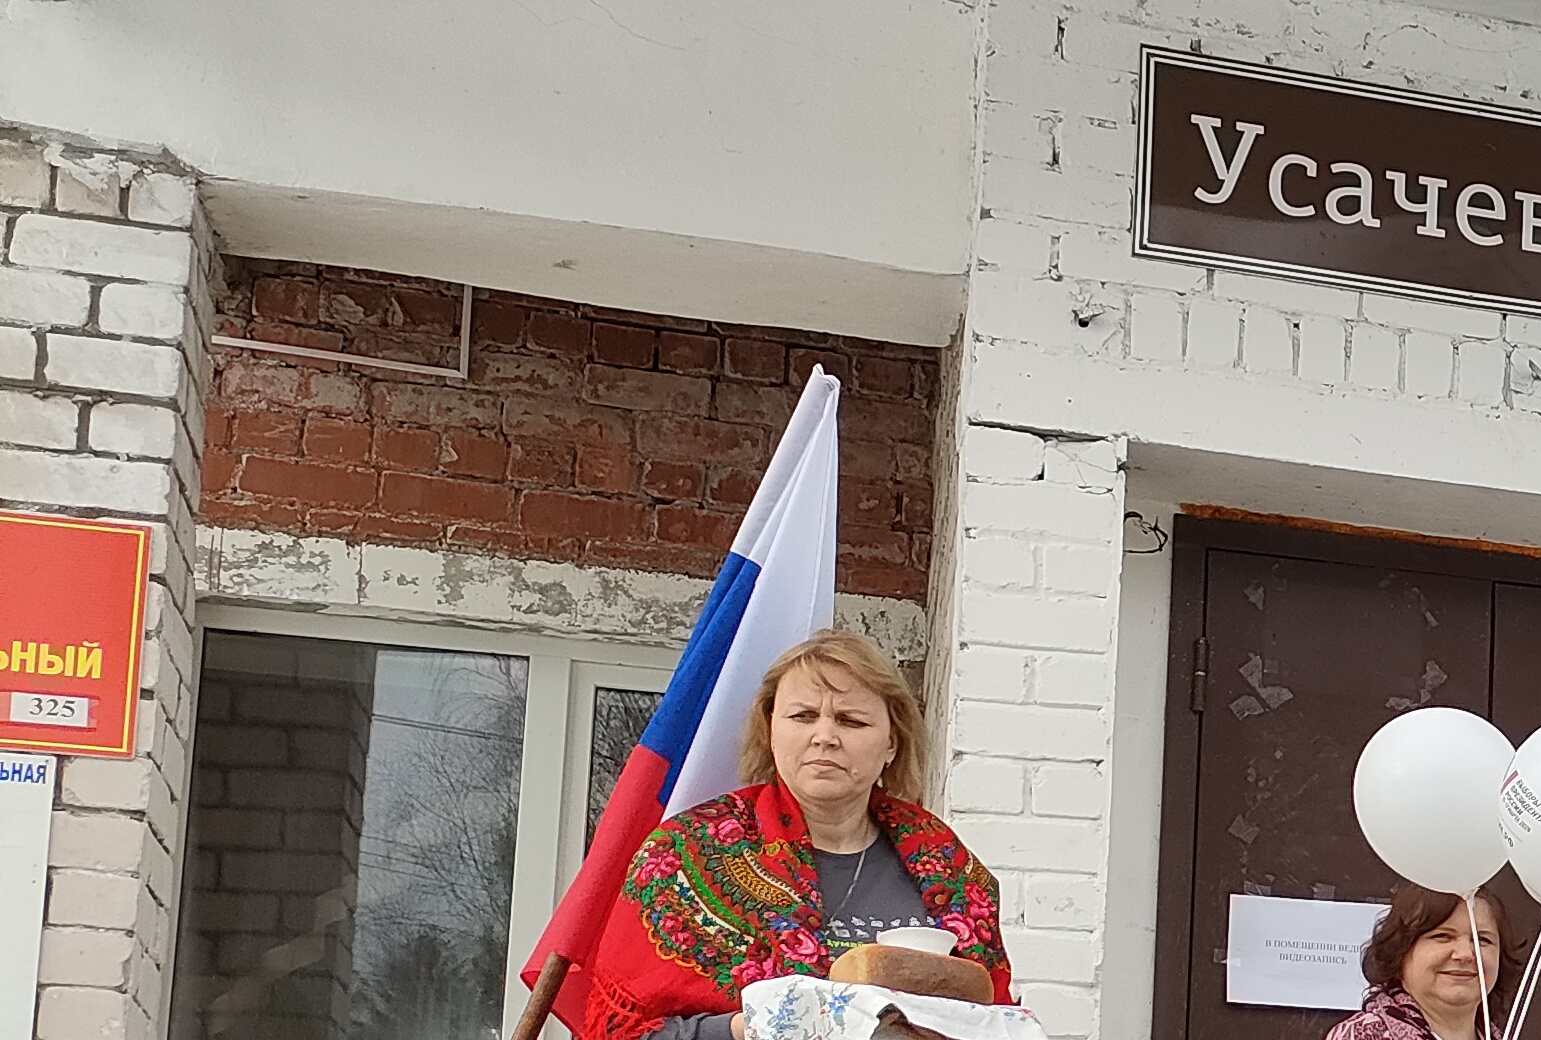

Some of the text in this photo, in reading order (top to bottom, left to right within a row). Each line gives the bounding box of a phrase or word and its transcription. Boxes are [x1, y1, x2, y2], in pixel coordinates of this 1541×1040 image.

[29, 697, 76, 718] 325
[1265, 939, 1360, 953] В ПОМЕЩЕНИИ ВЕД
[1279, 953, 1347, 965] ВИДЕОЗАПИСЬ
